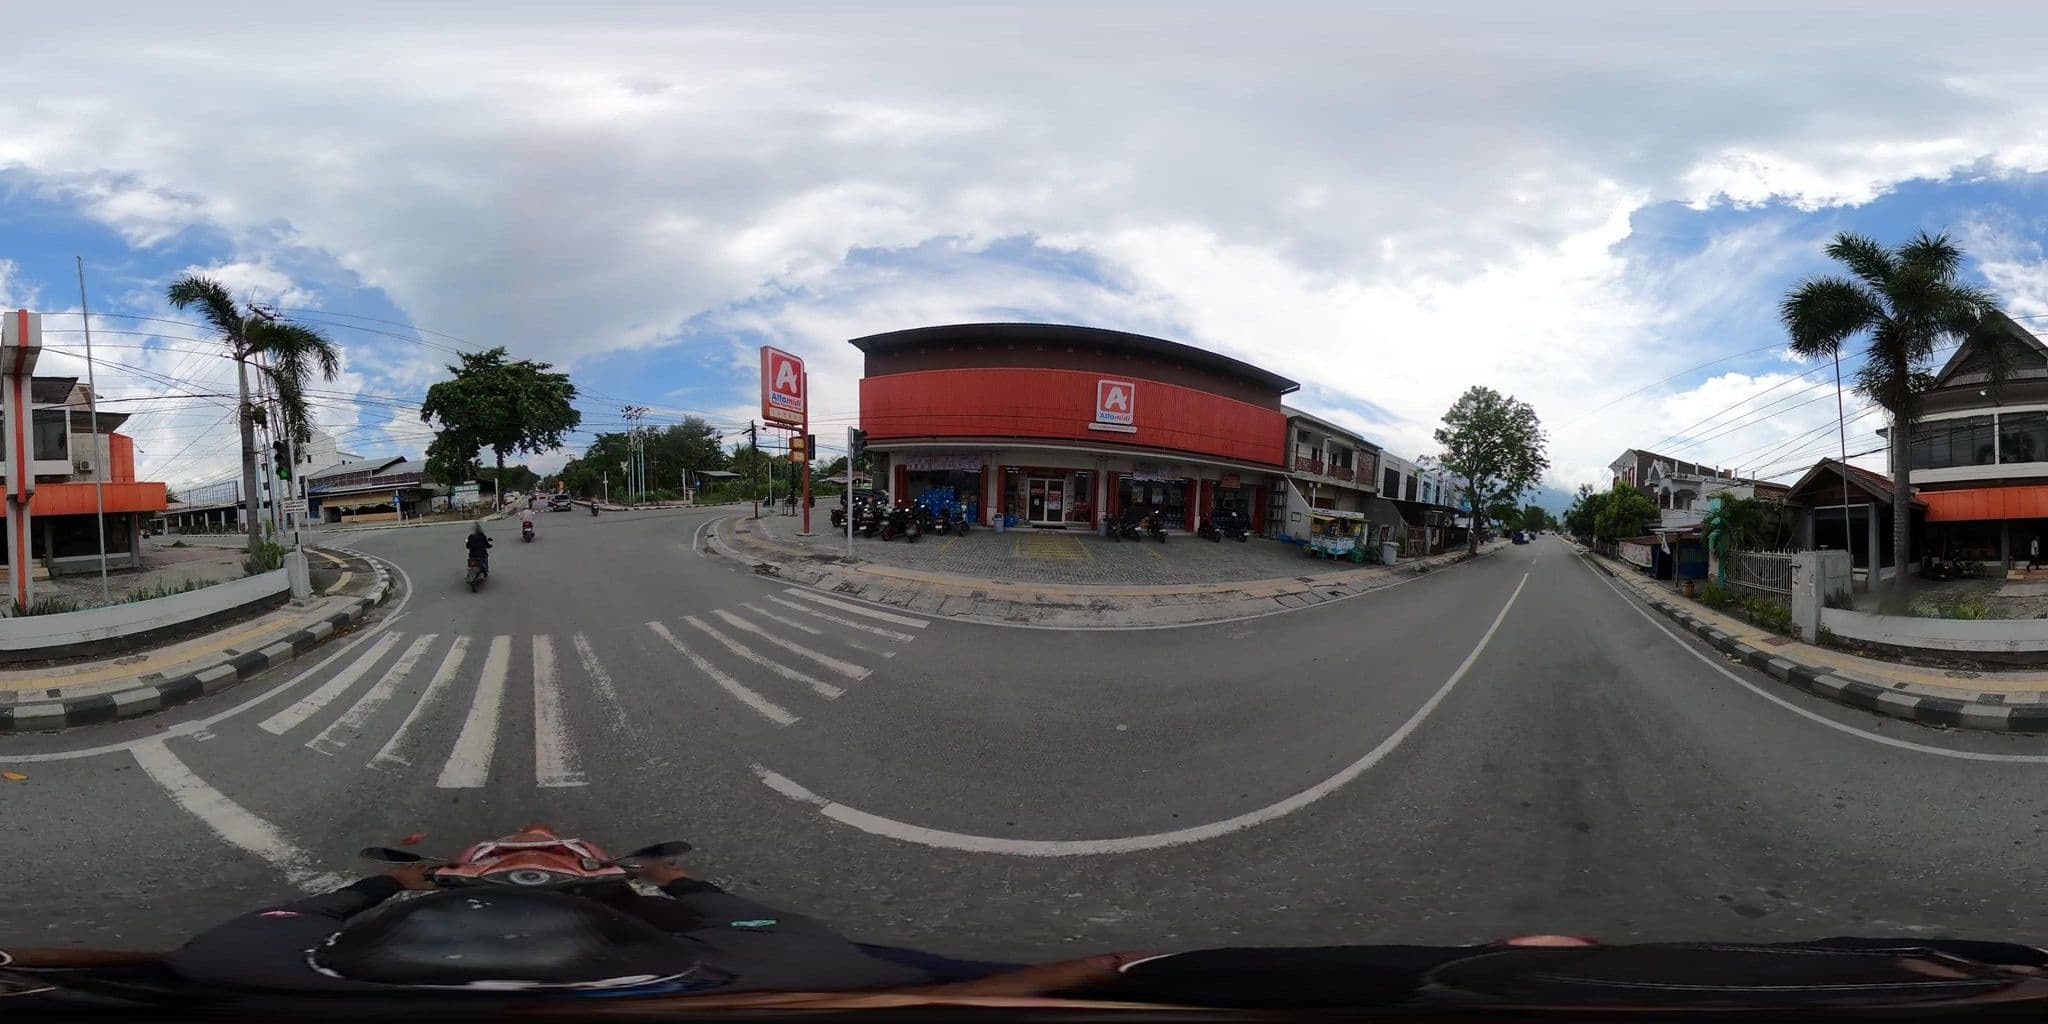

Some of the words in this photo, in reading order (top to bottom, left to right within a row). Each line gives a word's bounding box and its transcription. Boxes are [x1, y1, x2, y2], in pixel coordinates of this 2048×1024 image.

[776, 361, 797, 394] A
[771, 392, 801, 407] Alfamidi
[1105, 386, 1128, 411] A
[1099, 412, 1131, 421] Alfamidi
